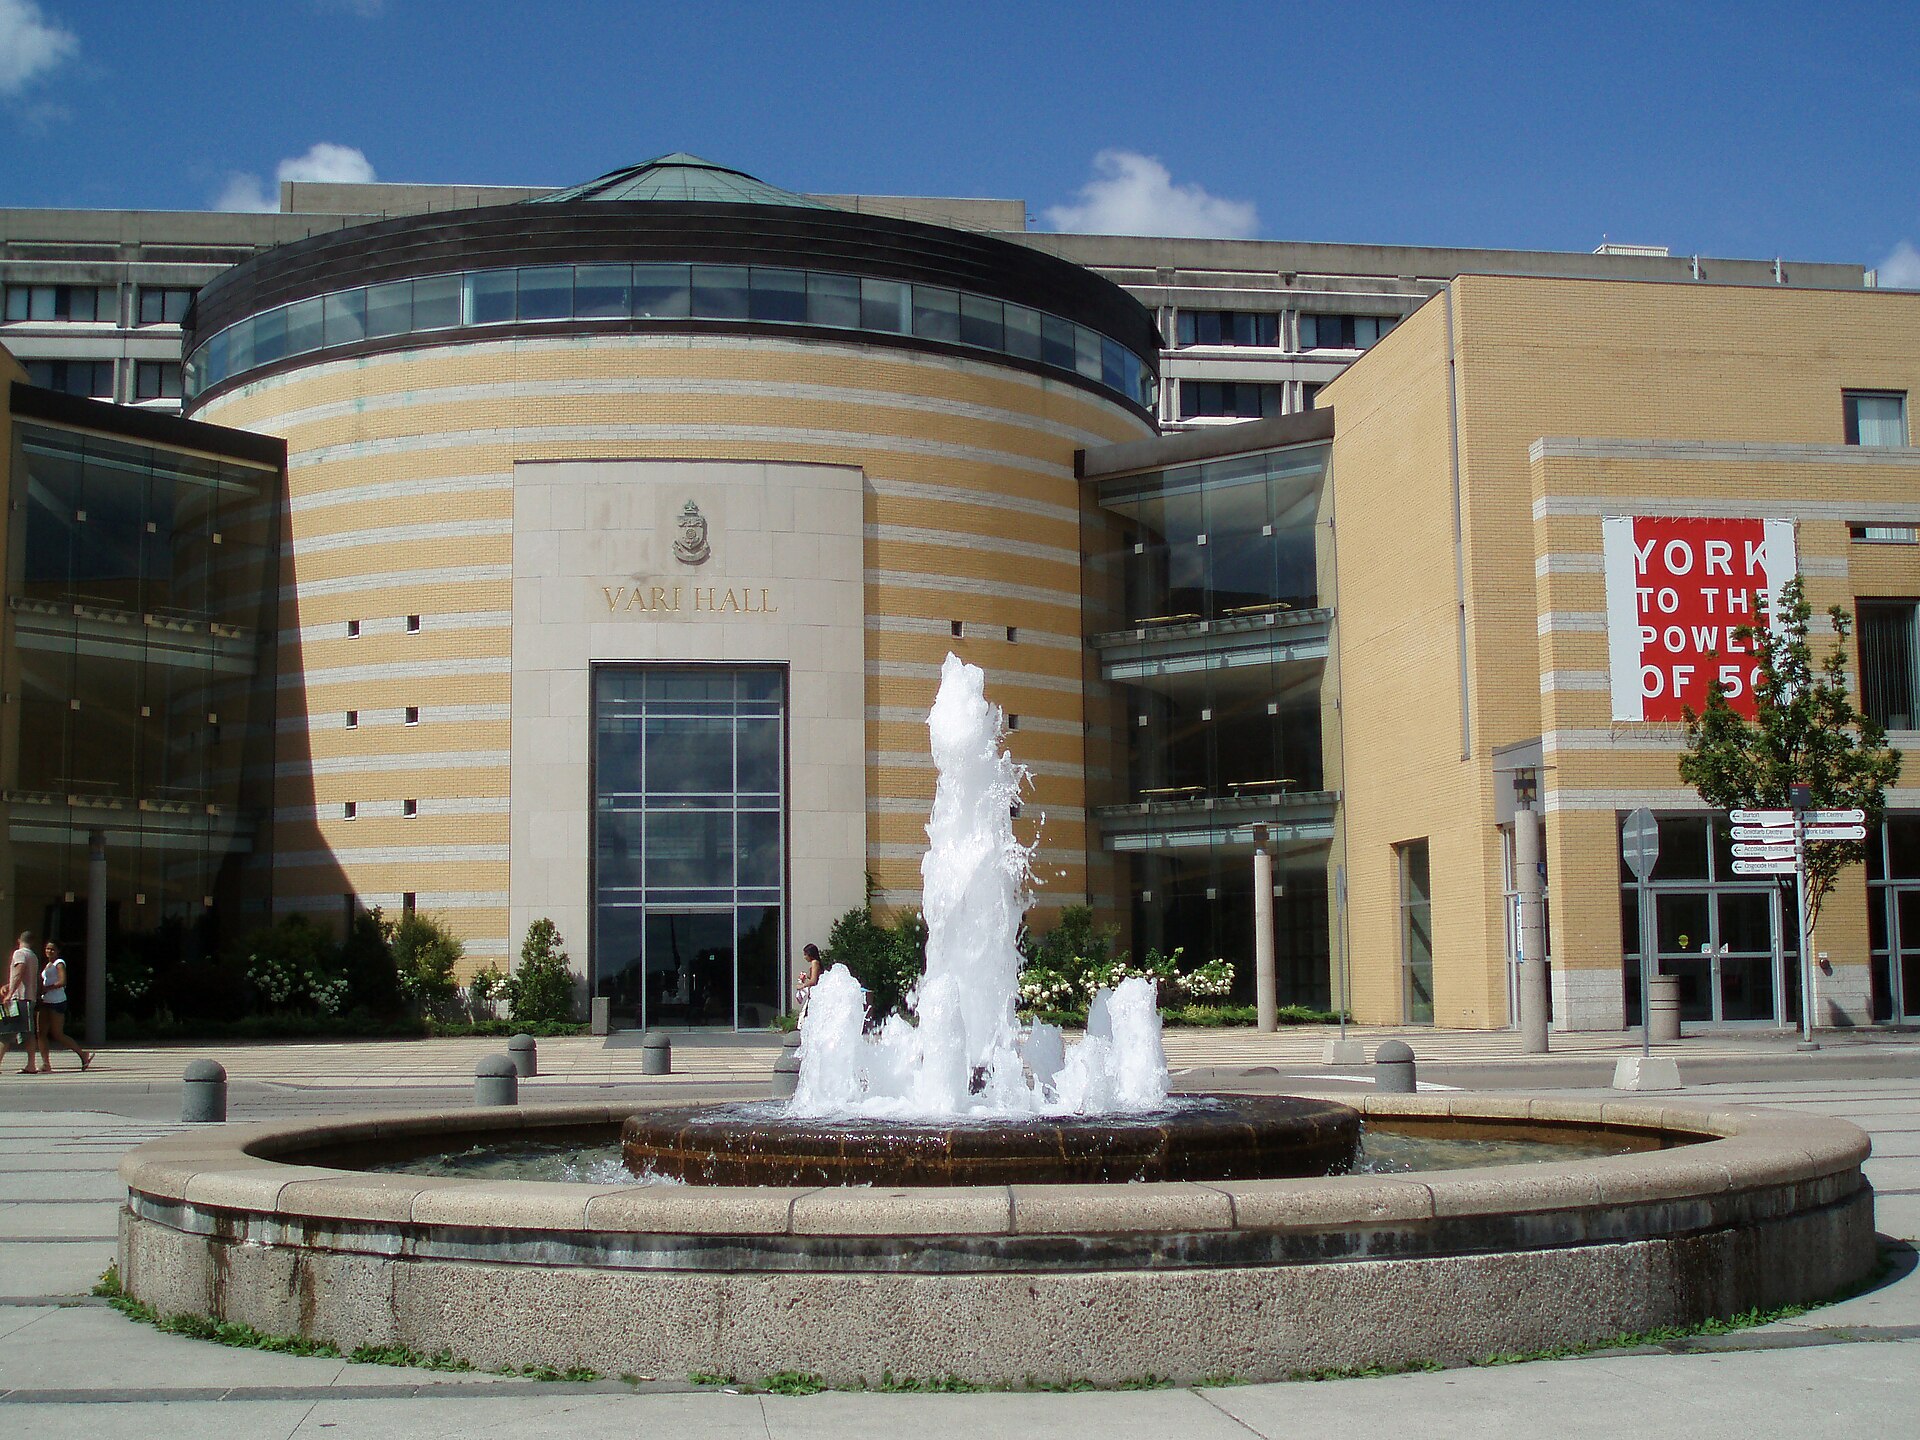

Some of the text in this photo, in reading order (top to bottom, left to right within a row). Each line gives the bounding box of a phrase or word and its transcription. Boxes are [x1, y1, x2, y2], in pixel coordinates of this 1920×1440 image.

[1633, 539, 1768, 577] YORK
[602, 586, 779, 613] VARI HALL
[1635, 587, 1769, 614] TO THE
[1640, 664, 1695, 699] OF
